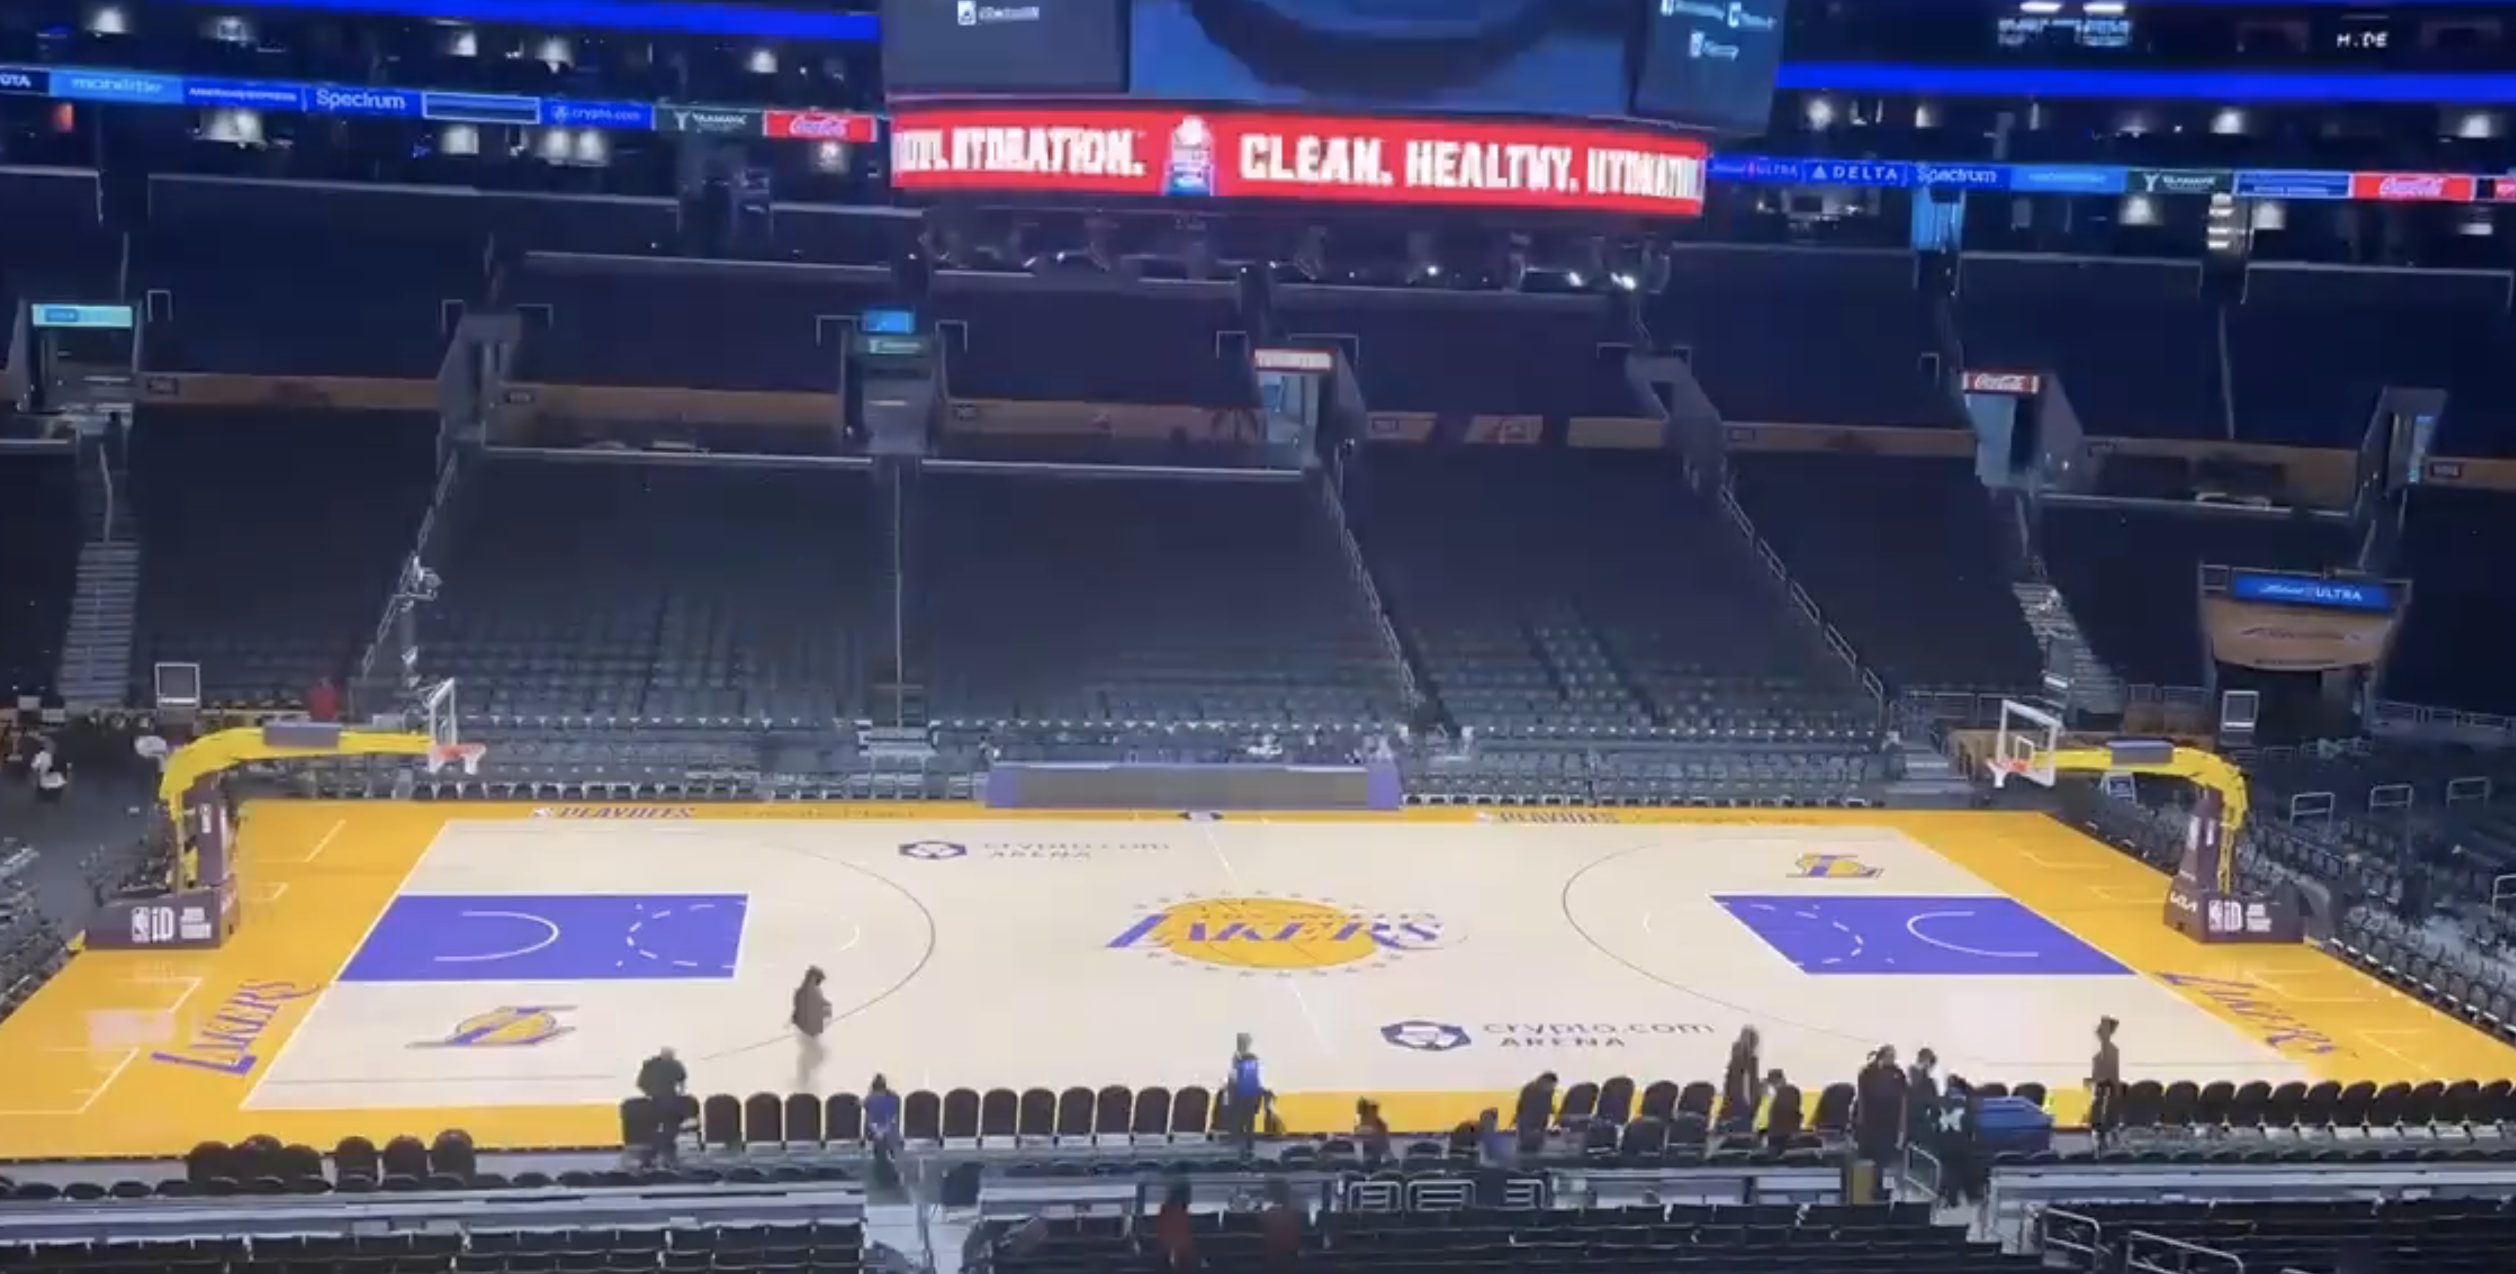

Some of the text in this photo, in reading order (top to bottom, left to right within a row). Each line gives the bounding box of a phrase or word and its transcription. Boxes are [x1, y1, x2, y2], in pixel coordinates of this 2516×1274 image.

[316, 89, 406, 110] Spectrum
[1240, 133, 1393, 185] CLEAN.
[1832, 165, 1898, 181] DELTA
[1917, 163, 1997, 184] Spectrum
[2316, 586, 2362, 602] ULTRA
[1104, 911, 1448, 951] LAKERS
[1484, 1024, 1716, 1036] crypto.com
[1500, 1037, 1626, 1047] ARENA
